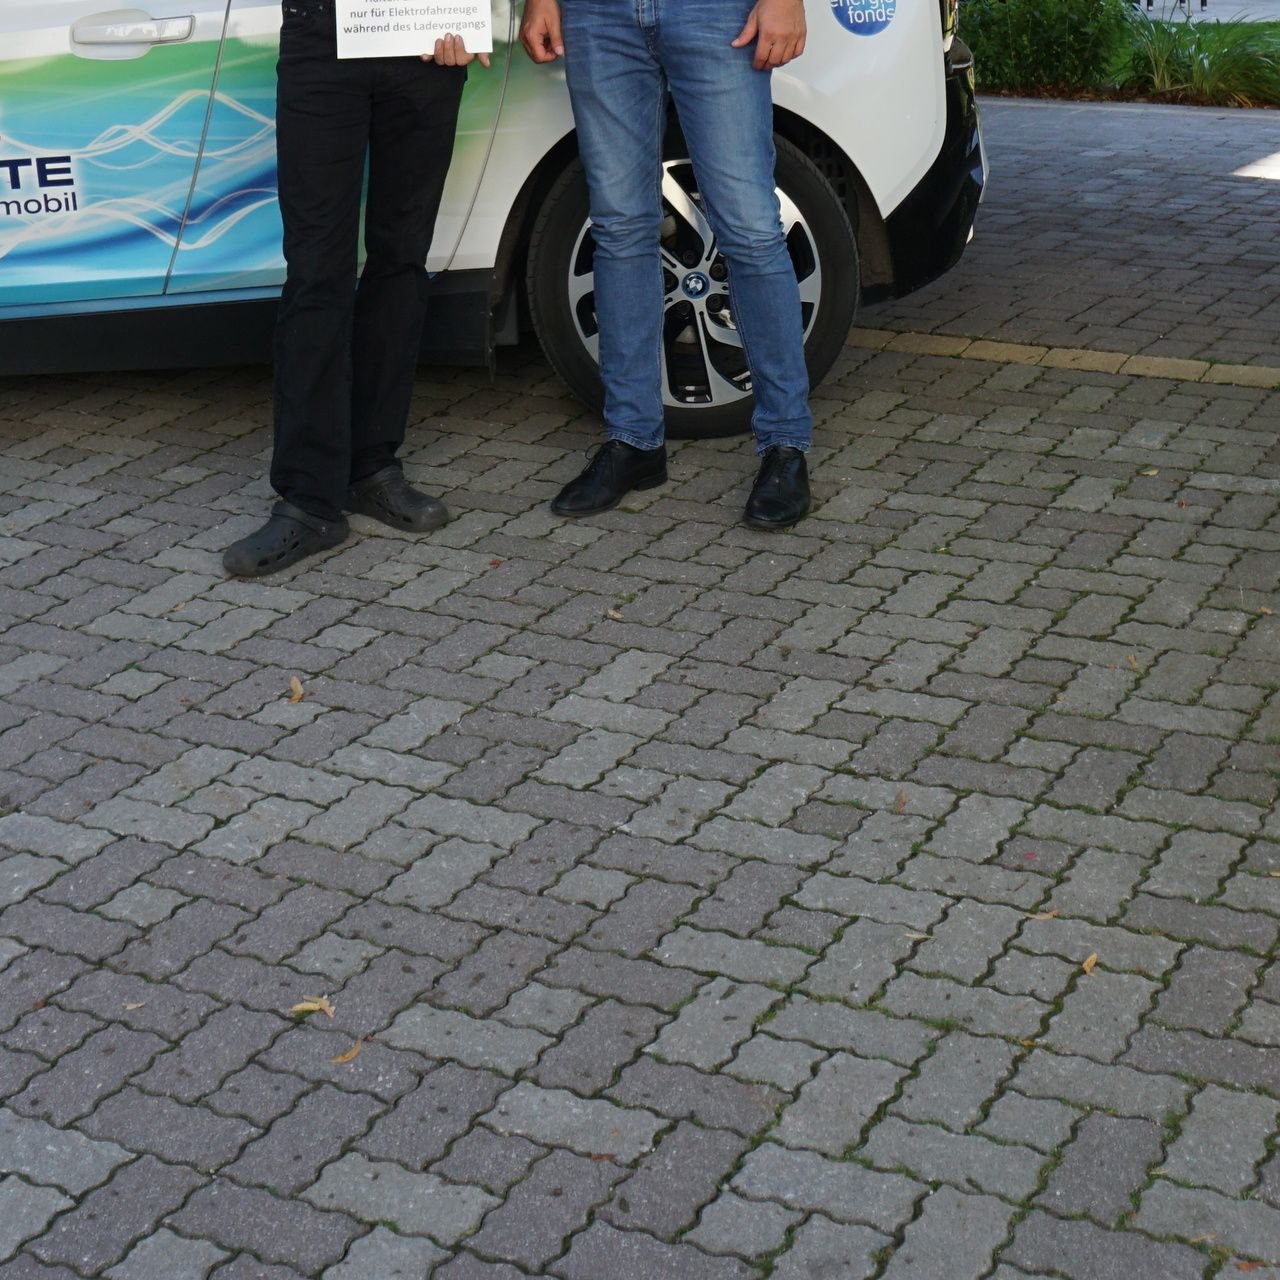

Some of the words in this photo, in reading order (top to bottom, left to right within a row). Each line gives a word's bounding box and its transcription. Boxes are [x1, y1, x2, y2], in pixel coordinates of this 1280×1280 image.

[350, 10, 368, 19] nur
[371, 7, 386, 17] für
[389, 5, 478, 17] Elektrofahrzeuge
[848, 4, 895, 24] fonds
[343, 23, 390, 34] während
[393, 22, 411, 31] des
[414, 20, 486, 32] Ladevorgangs
